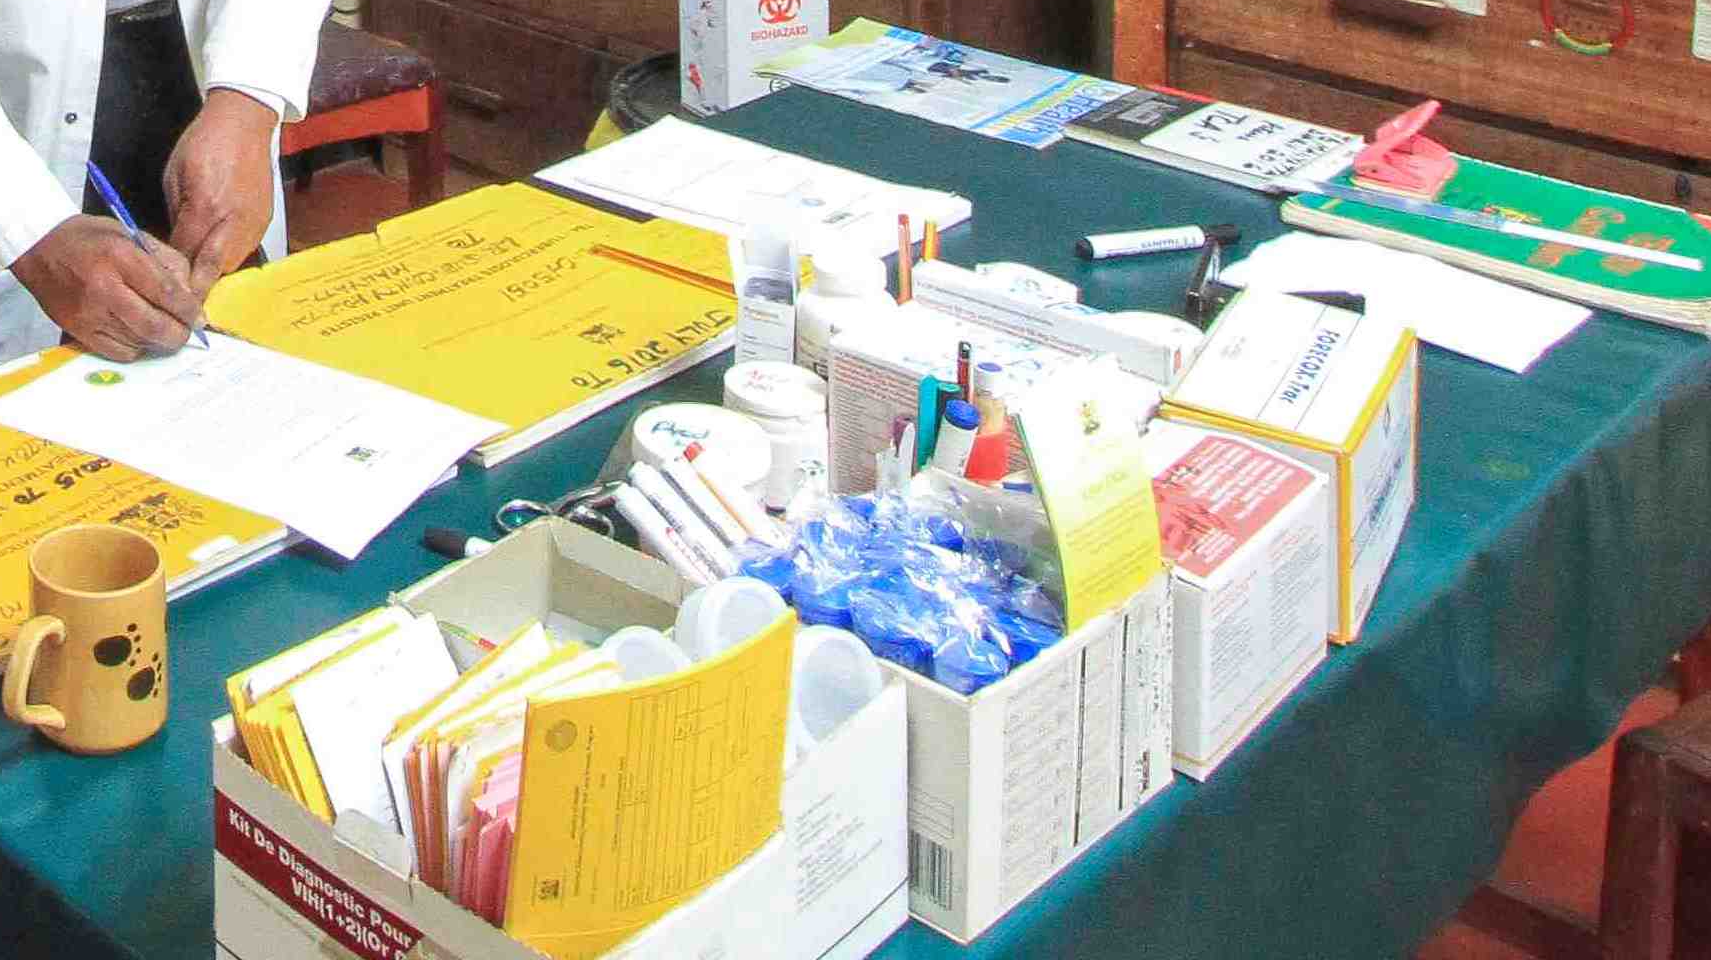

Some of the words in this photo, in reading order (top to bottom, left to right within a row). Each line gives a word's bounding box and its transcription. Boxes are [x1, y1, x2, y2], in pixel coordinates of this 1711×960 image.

[751, 25, 809, 41] BIOHAZARD
[667, 308, 734, 344] JULY
[608, 339, 664, 377] 2016
[226, 807, 252, 840] Kit
[253, 828, 277, 857] De
[278, 844, 367, 919] Diagnostic
[368, 908, 413, 951] Pour
